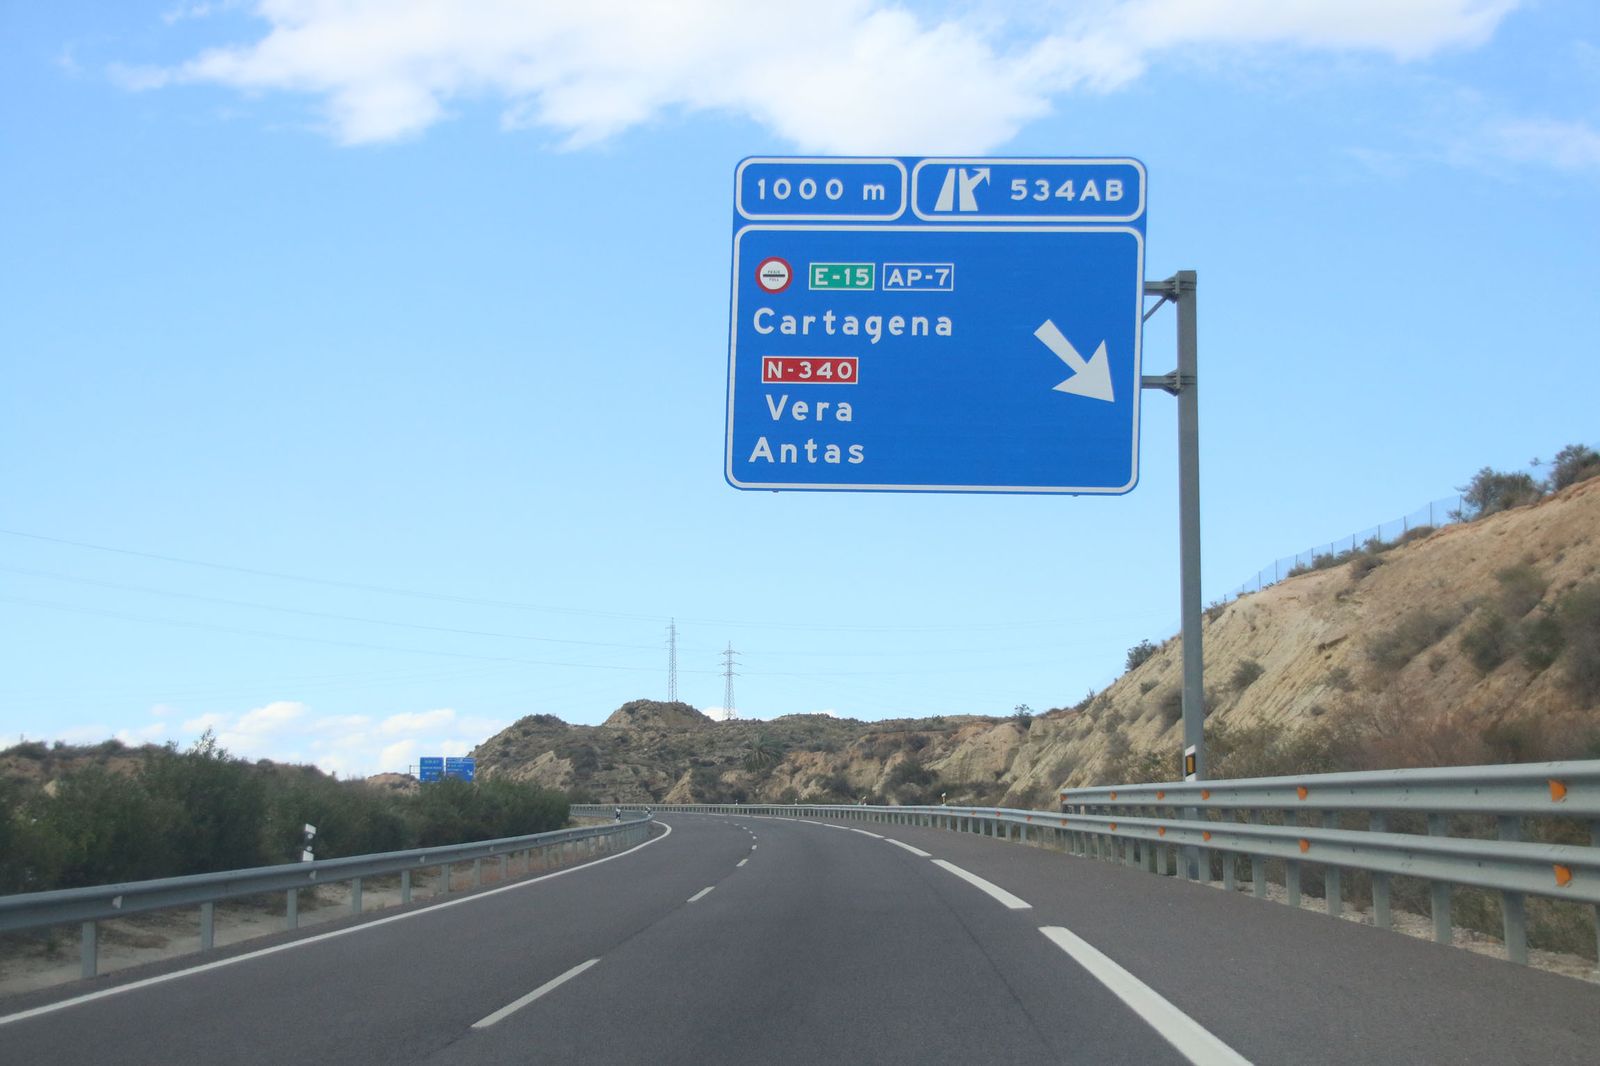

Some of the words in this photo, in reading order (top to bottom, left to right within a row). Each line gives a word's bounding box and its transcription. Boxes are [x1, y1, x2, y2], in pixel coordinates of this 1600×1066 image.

[758, 179, 843, 200] 1000
[863, 185, 884, 200] m
[1011, 179, 1123, 201] 534AB
[815, 268, 869, 285] E-15
[888, 269, 949, 286] AP-7
[754, 308, 952, 344] Cartagena
[768, 361, 852, 379] N-340
[766, 395, 852, 421] Vera
[749, 437, 864, 463] Antas
